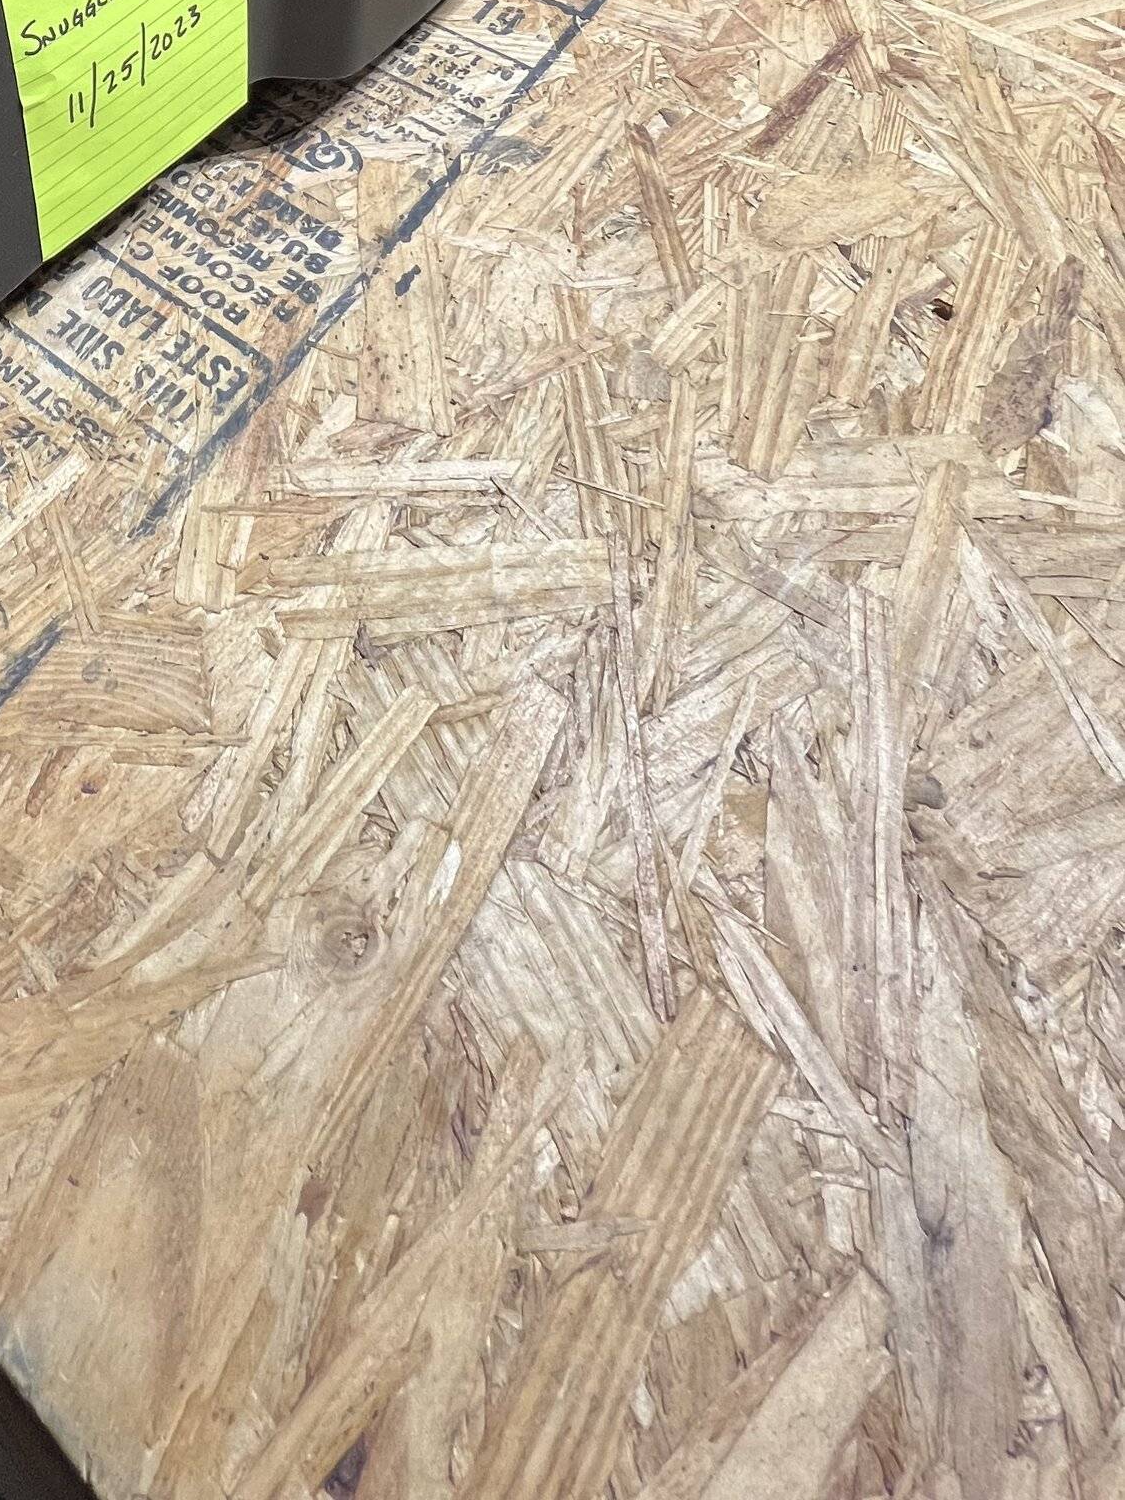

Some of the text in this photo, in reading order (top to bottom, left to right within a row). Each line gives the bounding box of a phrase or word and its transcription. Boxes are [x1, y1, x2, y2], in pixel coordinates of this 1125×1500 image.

[66, 3, 202, 128] 11/25/2023
[77, 272, 166, 345] LADO
[156, 258, 248, 326] ROOF
[277, 268, 322, 305] SE
[46, 307, 124, 375] SIDE
[123, 360, 199, 429] THIS
